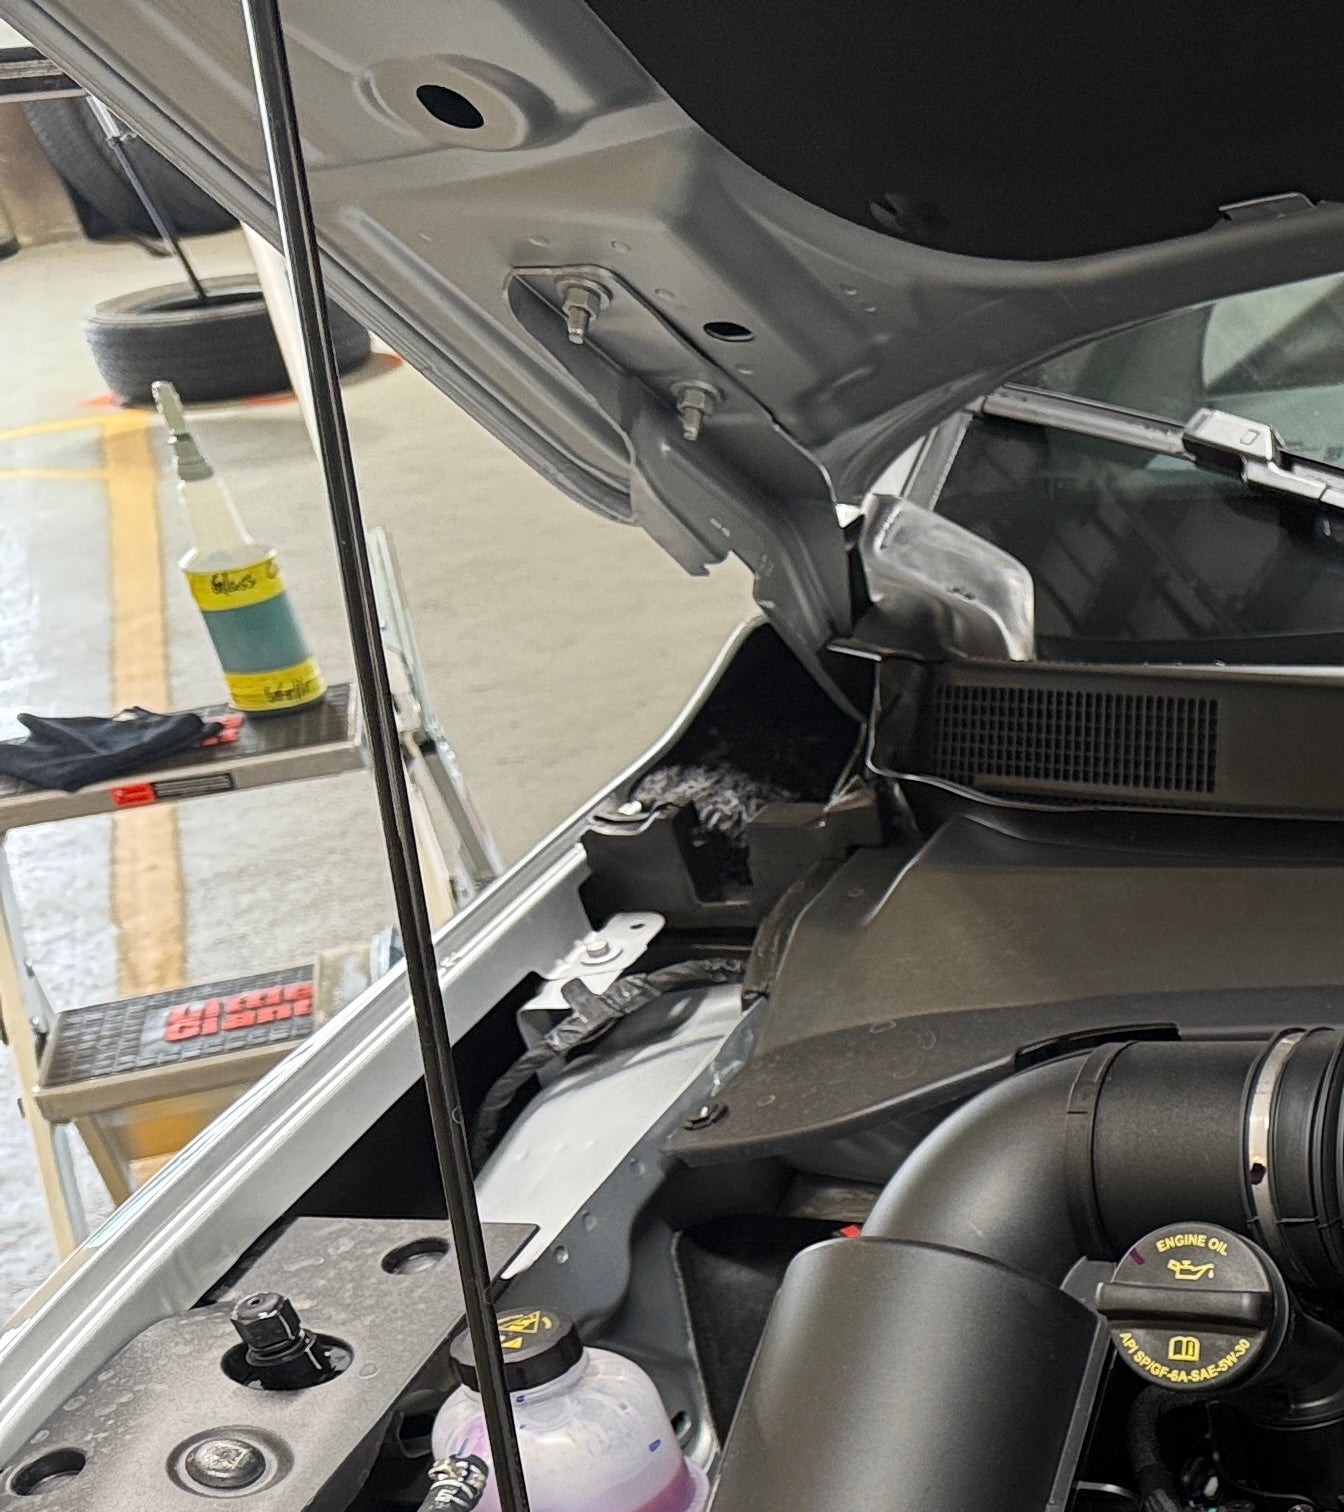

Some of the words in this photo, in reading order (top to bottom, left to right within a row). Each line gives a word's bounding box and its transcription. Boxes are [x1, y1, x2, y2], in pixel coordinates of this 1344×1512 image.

[1156, 1234, 1206, 1253] ENGINE
[1208, 1237, 1229, 1256] OIL
[1119, 1332, 1136, 1356] API
